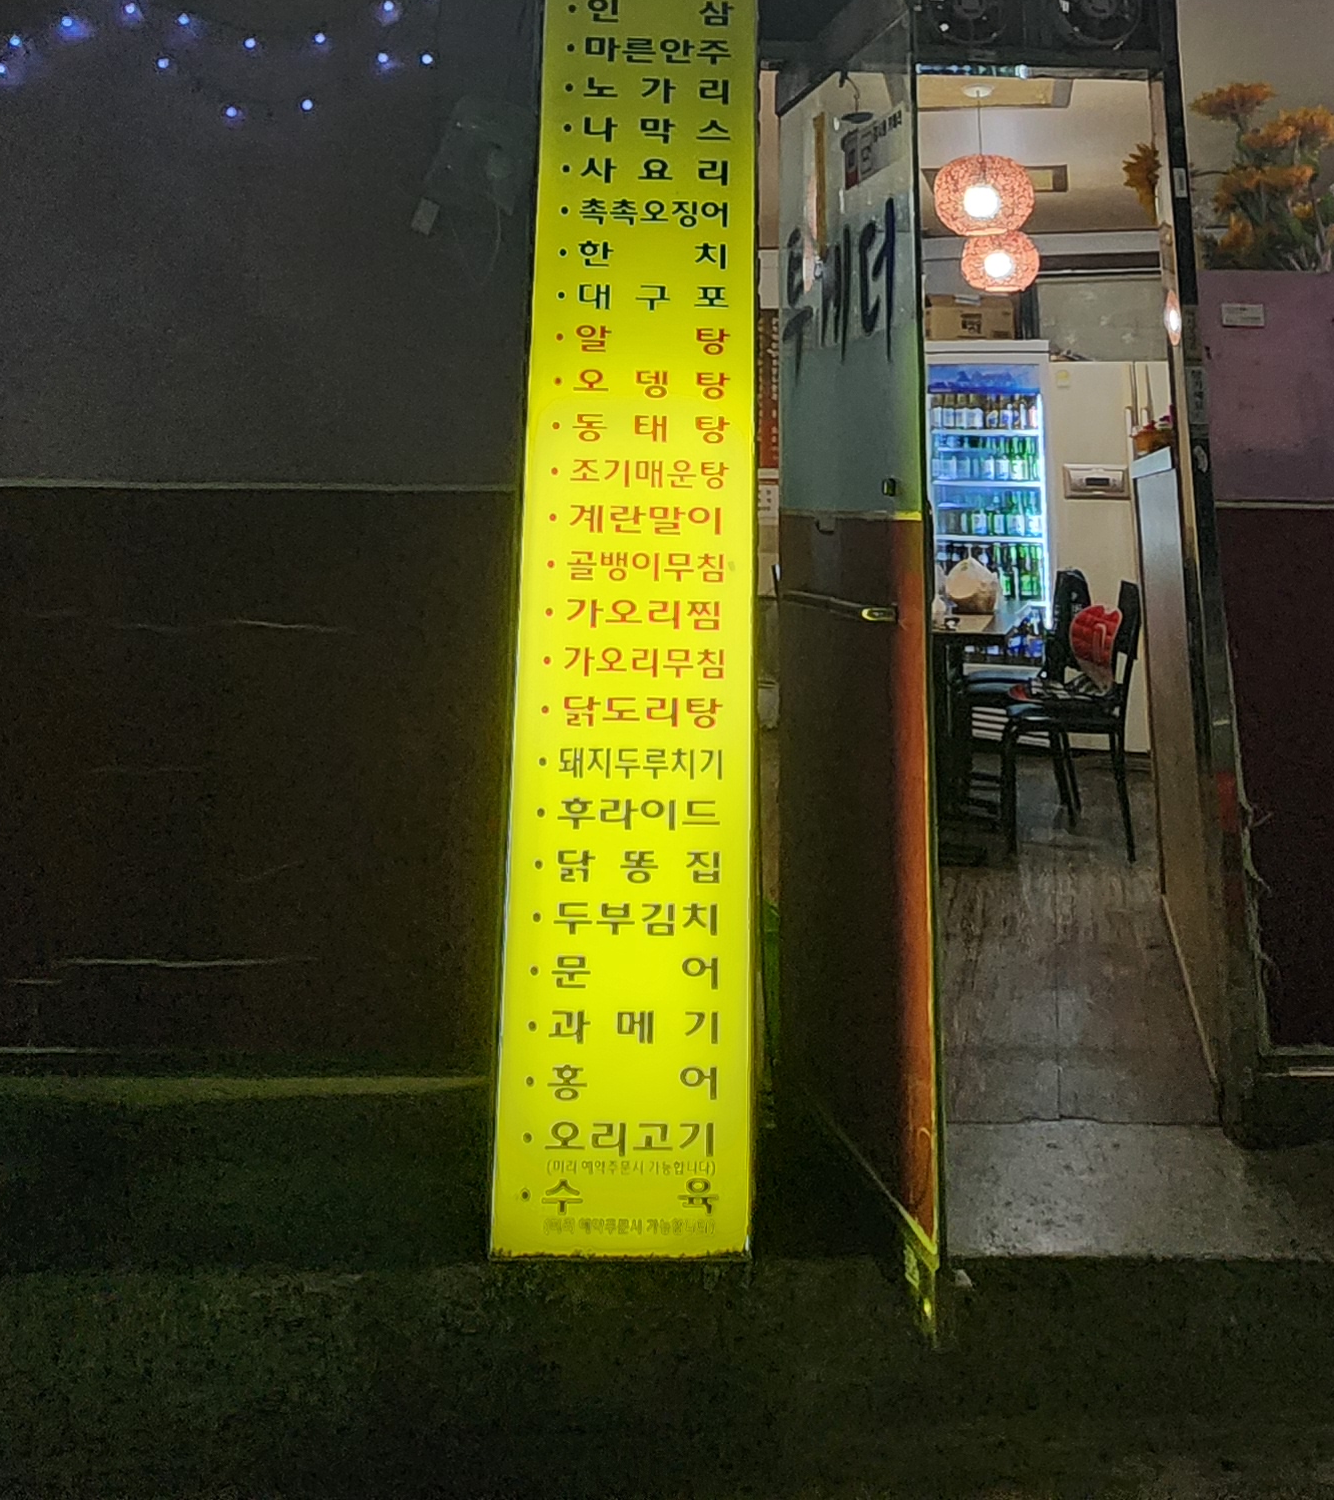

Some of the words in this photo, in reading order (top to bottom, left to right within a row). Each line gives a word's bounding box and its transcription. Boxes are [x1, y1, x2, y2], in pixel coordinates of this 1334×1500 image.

[585, 37, 731, 65] 마른안주
[579, 198, 729, 227] 촉촉오징어
[570, 459, 729, 489] 조기매운탕
[568, 505, 722, 536] 계란말이
[567, 551, 726, 583] 골뱅이무침
[567, 598, 722, 630] 가오리찜
[563, 647, 725, 679] 가오리무침
[563, 695, 723, 729] 닭도리탕
[558, 747, 724, 780] 돼지두루치기
[557, 797, 720, 830] 후라이드
[554, 902, 718, 936] 두부김치
[545, 1121, 715, 1156] 오리고기
